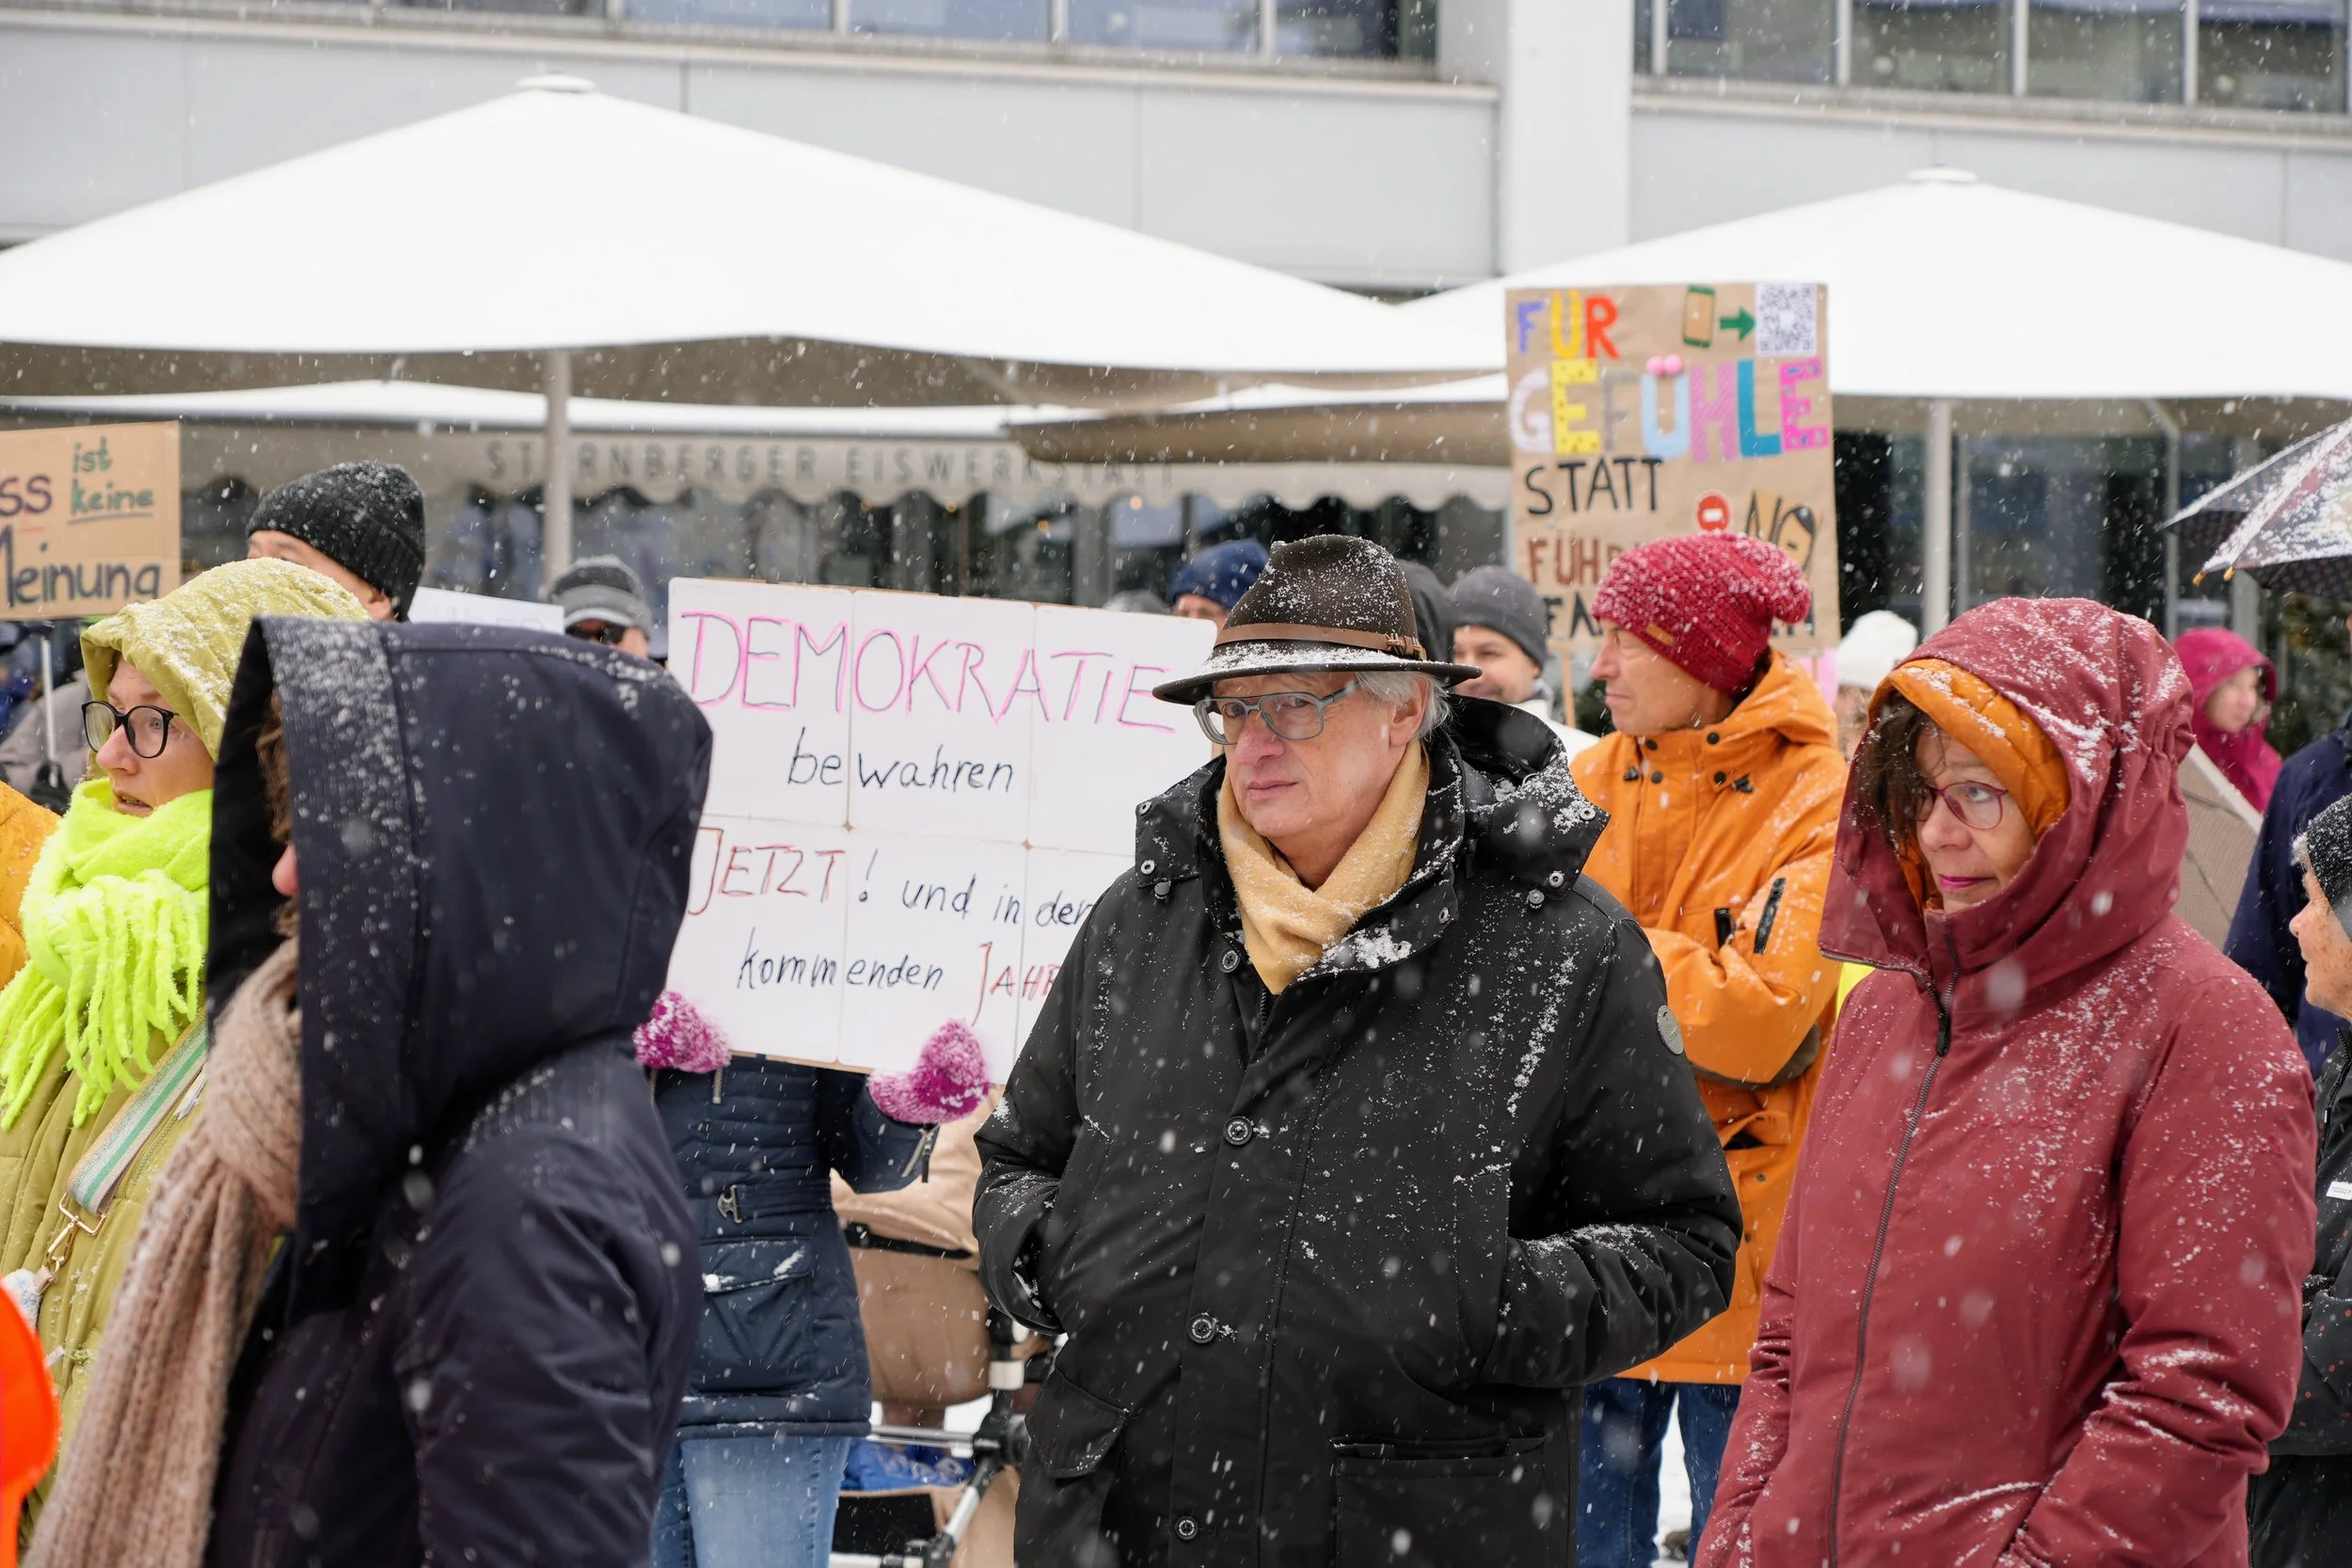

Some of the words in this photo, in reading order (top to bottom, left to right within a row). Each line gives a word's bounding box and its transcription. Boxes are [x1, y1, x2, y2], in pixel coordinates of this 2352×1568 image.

[1509, 355, 1830, 464] GEFÜHLE
[72, 436, 113, 473] ist
[485, 439, 817, 485] STRNBERGER
[1524, 455, 1663, 516] STATT
[71, 477, 155, 515] keine
[680, 610, 1176, 732] DEMOKRATIE
[687, 826, 846, 916] JETZT
[901, 873, 977, 922] und
[992, 882, 1023, 925] in
[737, 927, 944, 992] kommenden
